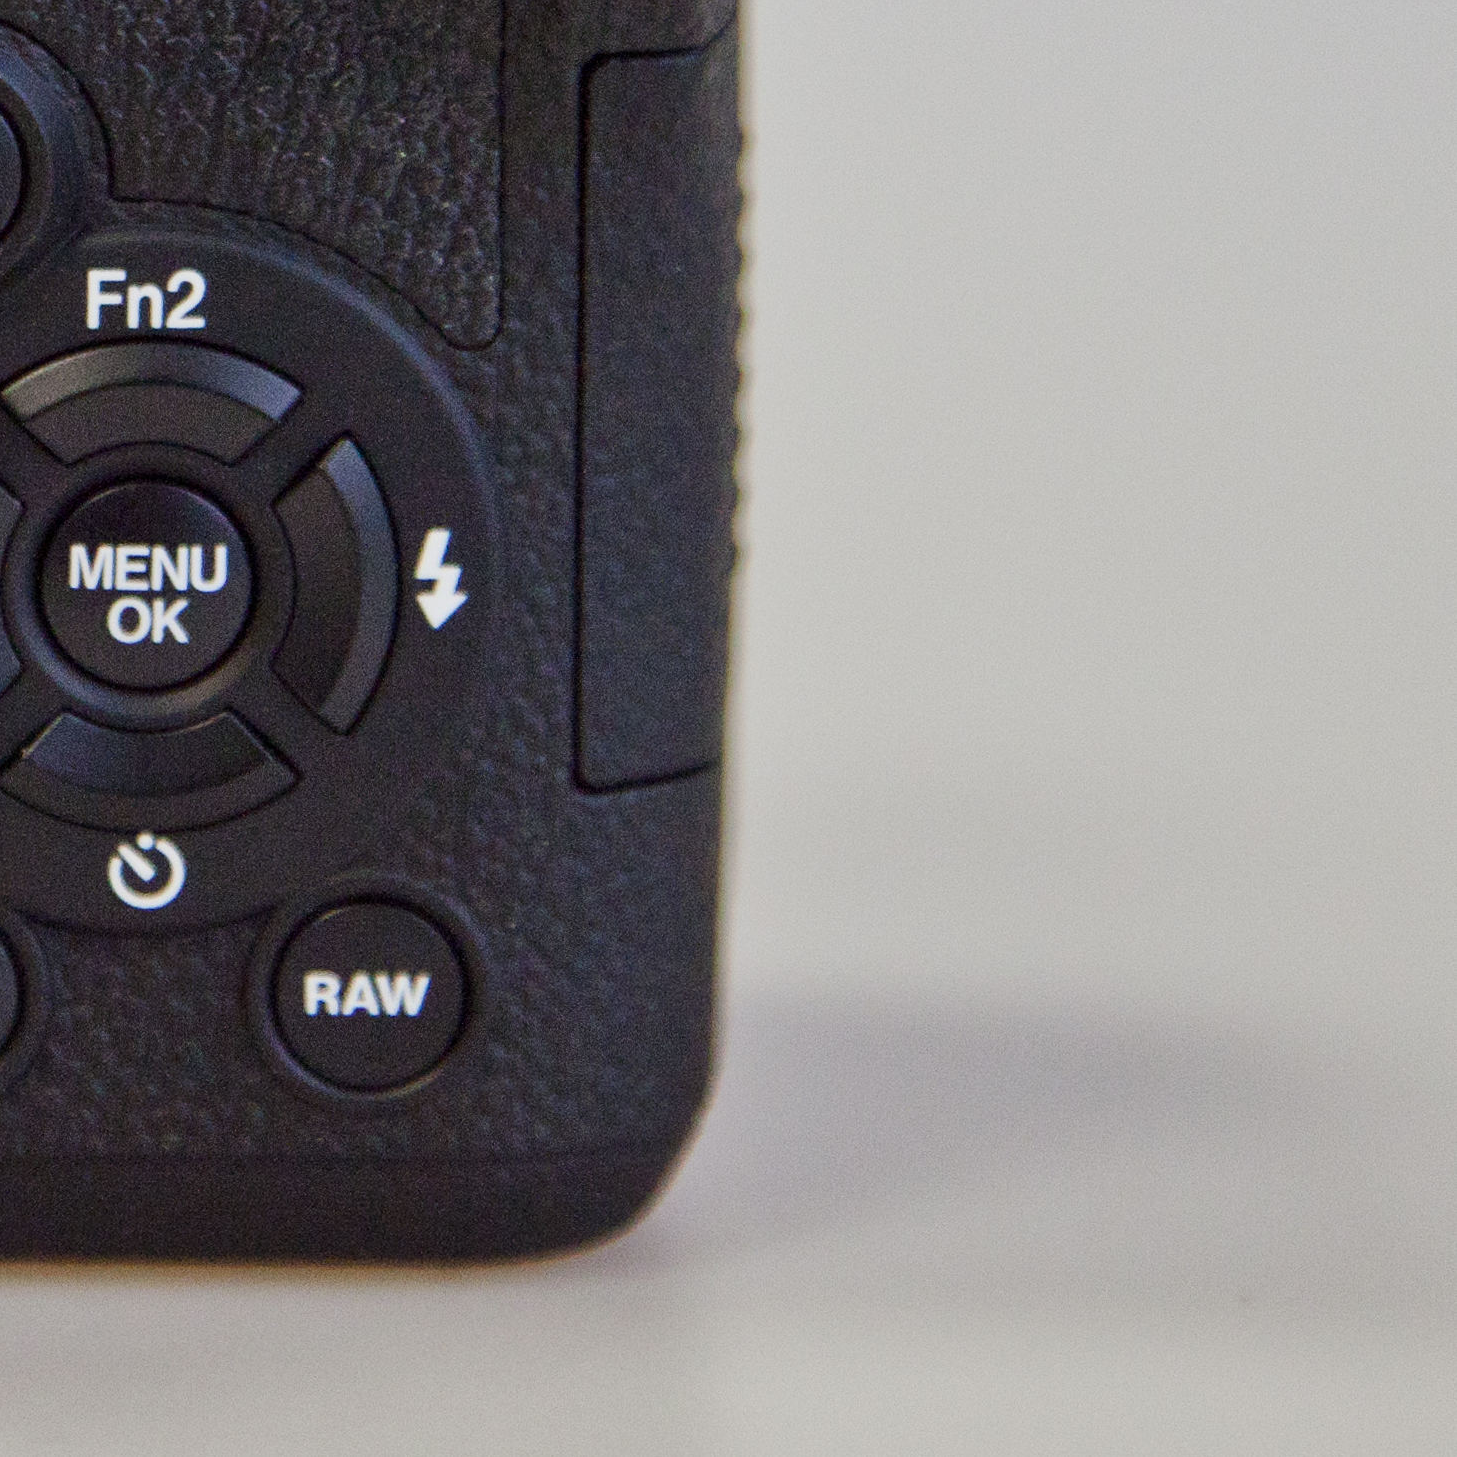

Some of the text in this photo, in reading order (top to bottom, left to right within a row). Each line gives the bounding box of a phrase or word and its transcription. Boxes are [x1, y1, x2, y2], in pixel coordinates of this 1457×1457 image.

[85, 268, 208, 329] Fn2
[68, 544, 229, 593] MENU
[107, 597, 190, 646] OK
[303, 973, 430, 1017] RAW
